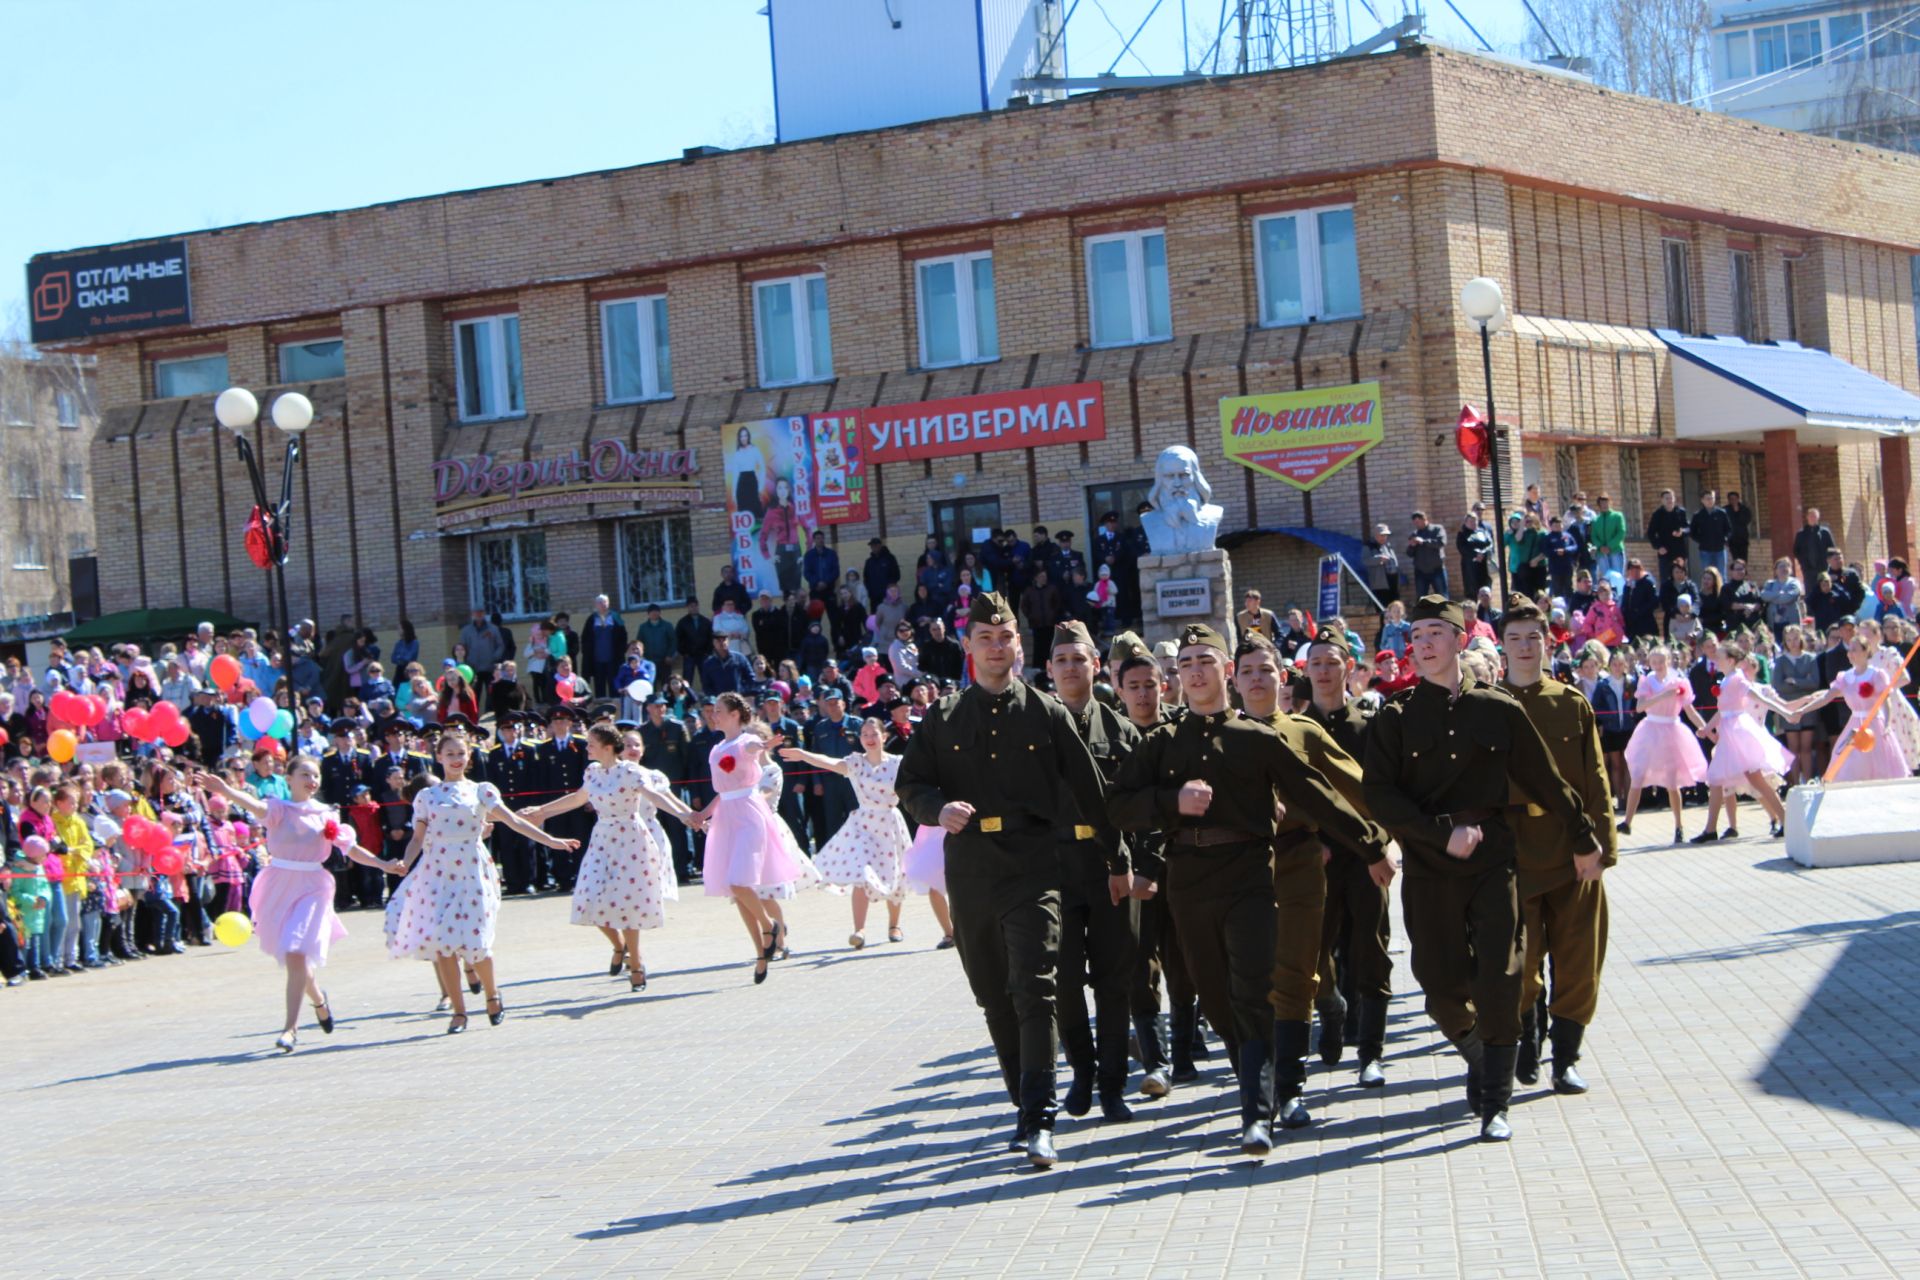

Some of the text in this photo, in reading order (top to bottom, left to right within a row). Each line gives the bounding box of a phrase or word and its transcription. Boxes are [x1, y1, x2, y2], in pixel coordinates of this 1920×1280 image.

[76, 258, 183, 289] ОТЛИЧНЫЕ
[77, 286, 130, 309] ОКНА
[868, 397, 1096, 452] УНИВЕРМАГ
[1231, 400, 1375, 438] Новинка
[790, 418, 808, 512] БЛУЗКИ
[735, 513, 755, 590] ЮБКИ
